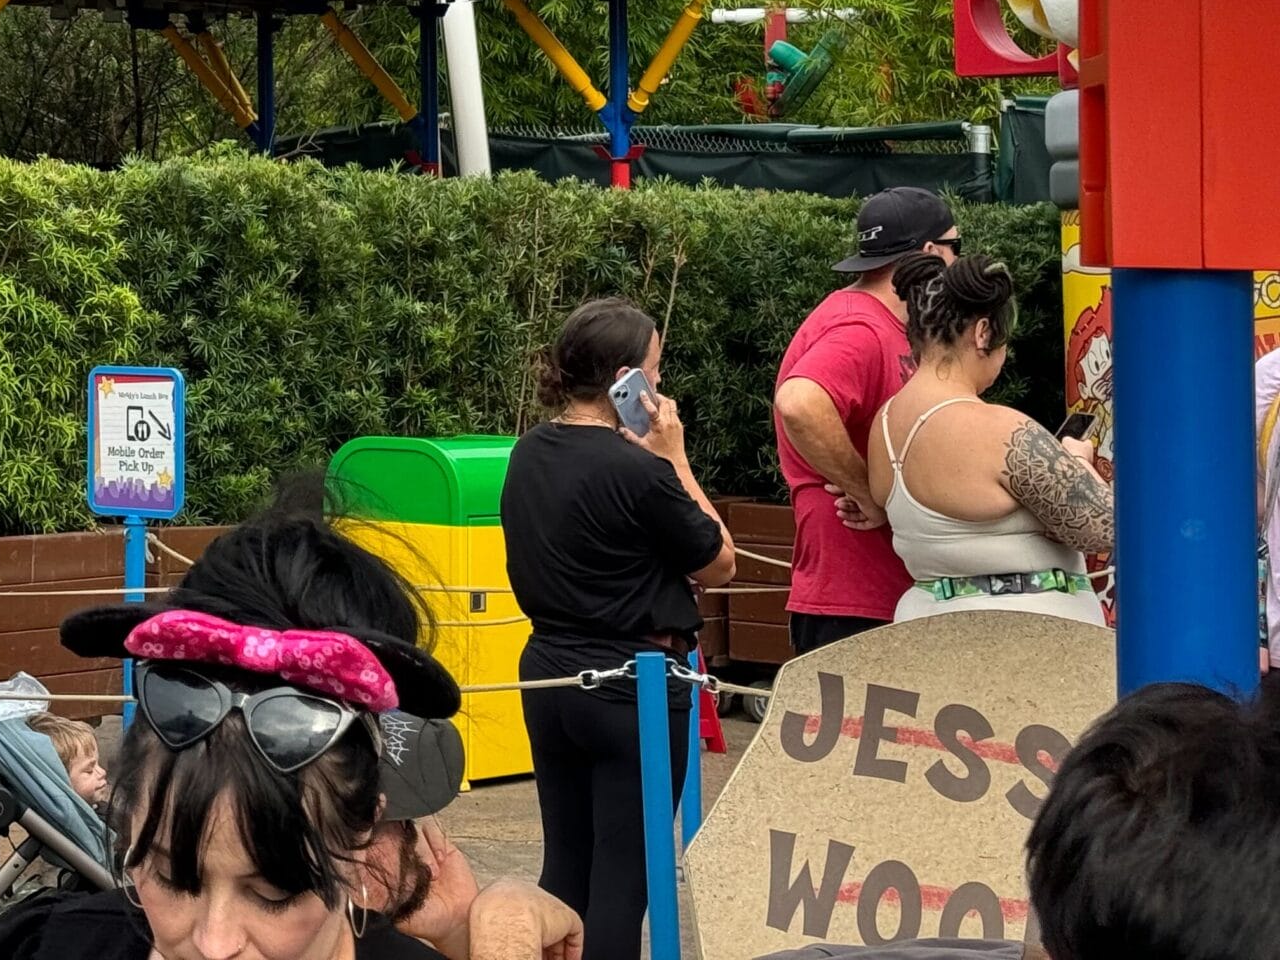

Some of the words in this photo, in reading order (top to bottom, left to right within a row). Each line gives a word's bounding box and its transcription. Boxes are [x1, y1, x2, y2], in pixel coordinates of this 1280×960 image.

[107, 445, 136, 458] Mobile
[138, 447, 165, 459] Order
[118, 460, 140, 472] Pick
[140, 461, 154, 475] Up
